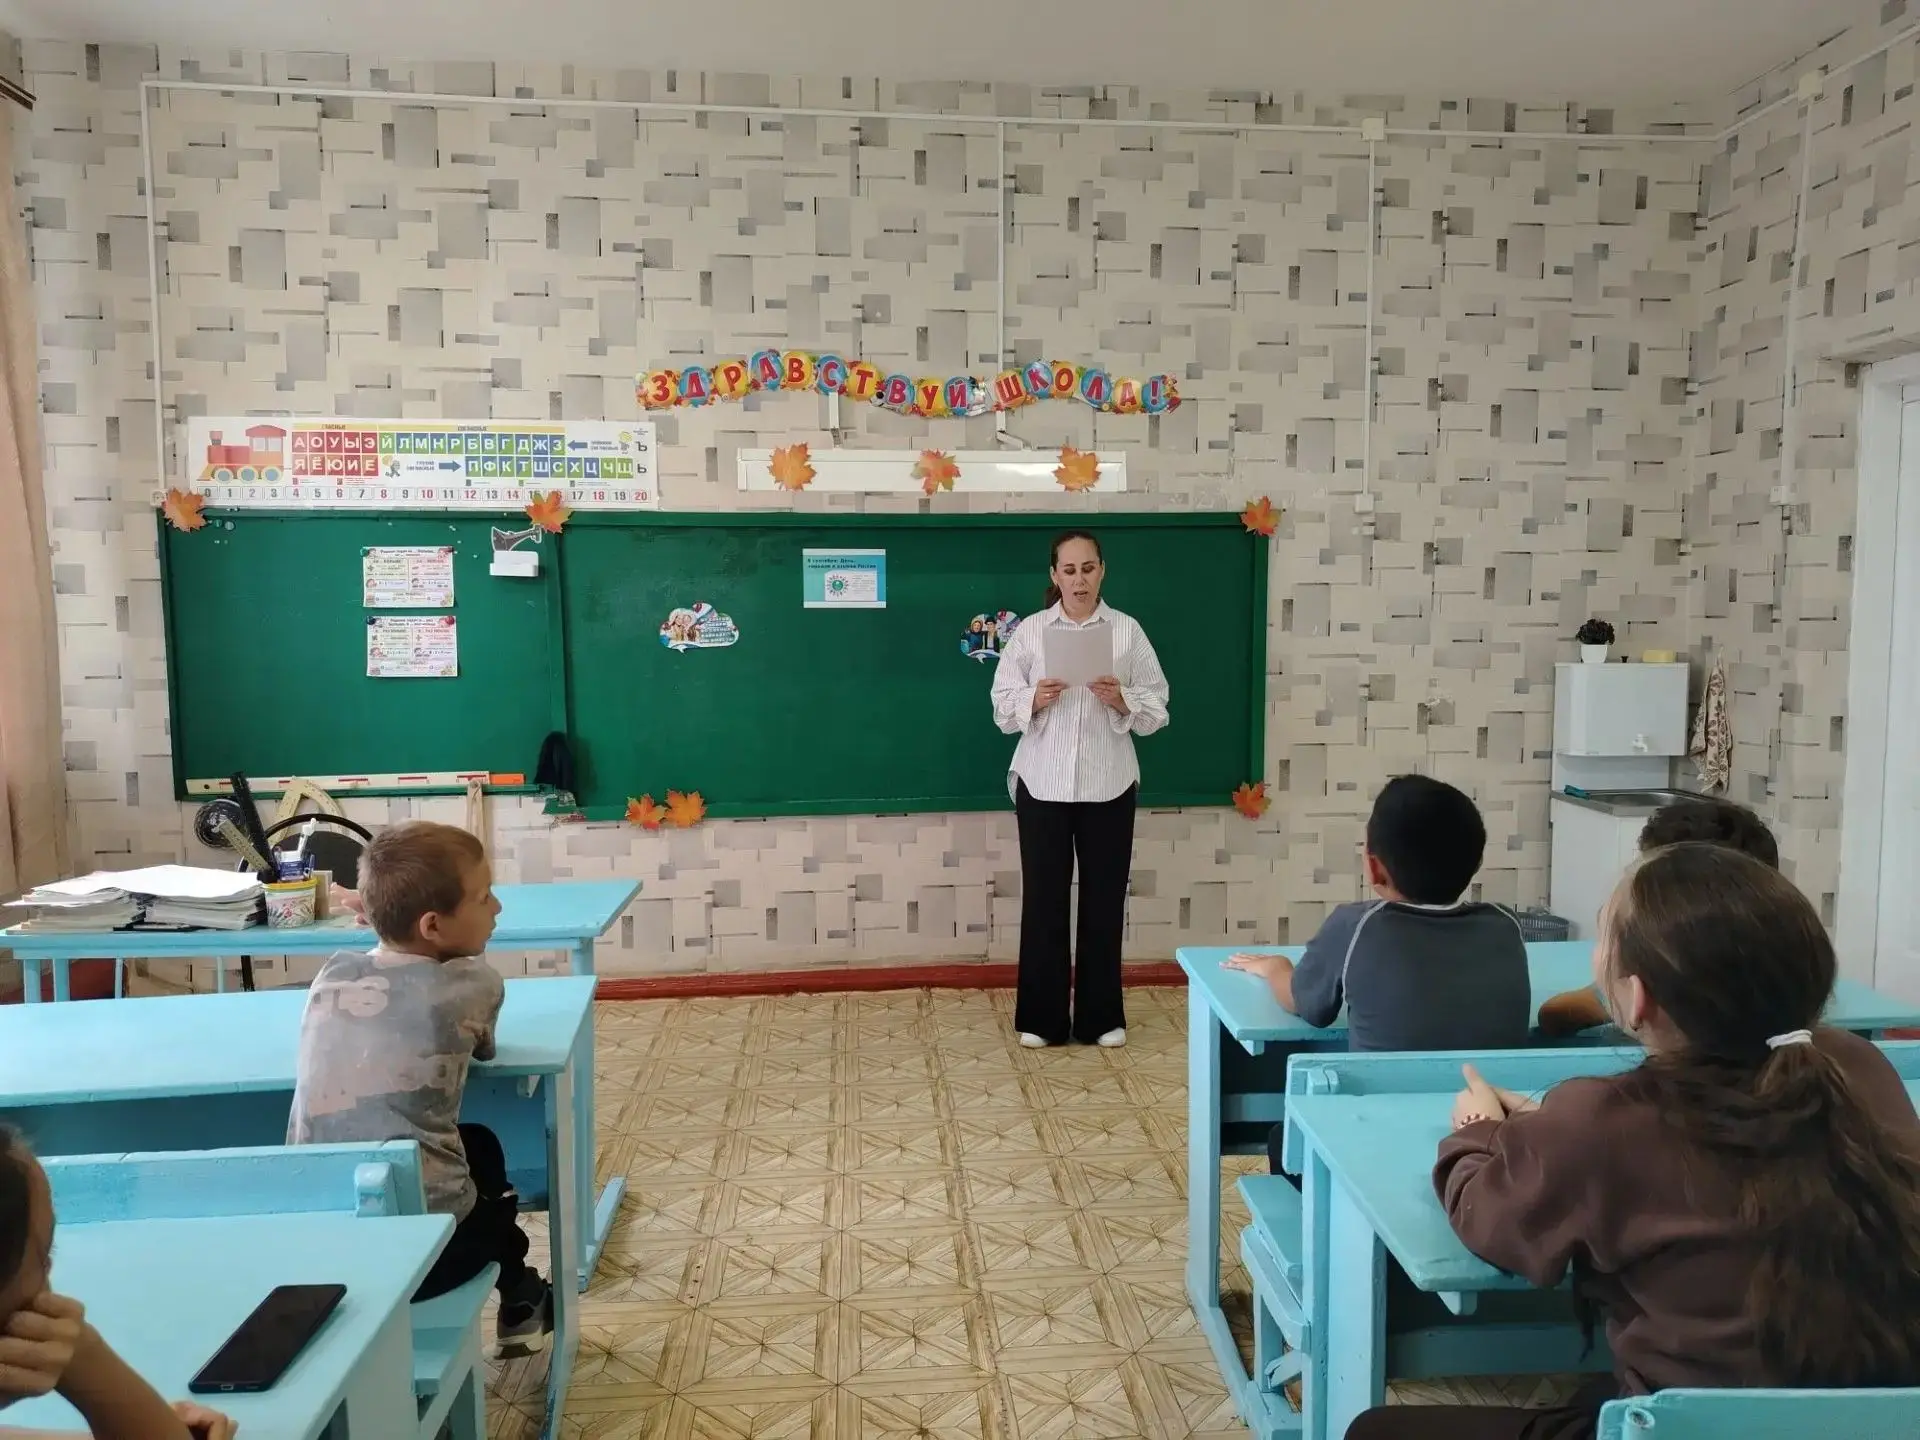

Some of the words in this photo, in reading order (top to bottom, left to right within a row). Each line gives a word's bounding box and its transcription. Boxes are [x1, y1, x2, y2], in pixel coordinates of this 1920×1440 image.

[651, 357, 969, 410] ЗДРАВСТВУЙ
[996, 366, 1159, 407] ШКОЛА!
[293, 437, 306, 448] А
[310, 436, 322, 448] О
[329, 436, 341, 448] У
[344, 436, 359, 448] Ы
[364, 436, 376, 448] Э
[381, 434, 393, 448] Й
[398, 437, 410, 449] Л
[415, 437, 428, 449] М
[433, 438, 444, 449] Н
[450, 438, 461, 449] Р
[467, 438, 478, 449] Б
[484, 439, 494, 449] В
[501, 439, 510, 449] Г
[517, 439, 530, 451] Д
[533, 439, 549, 451] Ж
[552, 439, 562, 451] З
[293, 459, 305, 471] Я
[314, 457, 323, 471] Ё
[327, 460, 343, 471] Ю
[347, 460, 359, 471] И
[365, 460, 376, 472] Е
[468, 461, 479, 472] П
[483, 460, 496, 472] Ф
[502, 461, 512, 472] К
[519, 461, 529, 473] Т
[533, 461, 549, 473] Ш
[552, 462, 564, 473] С
[569, 462, 581, 473] Х
[585, 462, 598, 475] Ц
[603, 462, 613, 474] Ч
[617, 462, 633, 476] Щ
[204, 488, 212, 498] 0
[227, 488, 233, 498] 1
[249, 488, 256, 498] 2
[270, 488, 278, 498] 3
[293, 488, 300, 498] 4
[314, 488, 322, 498] 5
[336, 488, 343, 498] 6
[358, 488, 365, 498] 7
[380, 488, 387, 498] 8
[402, 489, 409, 499] 9
[421, 489, 434, 499] 10
[443, 489, 454, 499] 11
[464, 490, 477, 499] 12
[486, 490, 498, 499] 13
[506, 490, 520, 499] 14
[572, 491, 584, 500] 17
[593, 491, 605, 501] 18
[614, 491, 627, 501] 19
[634, 491, 648, 501] 20
